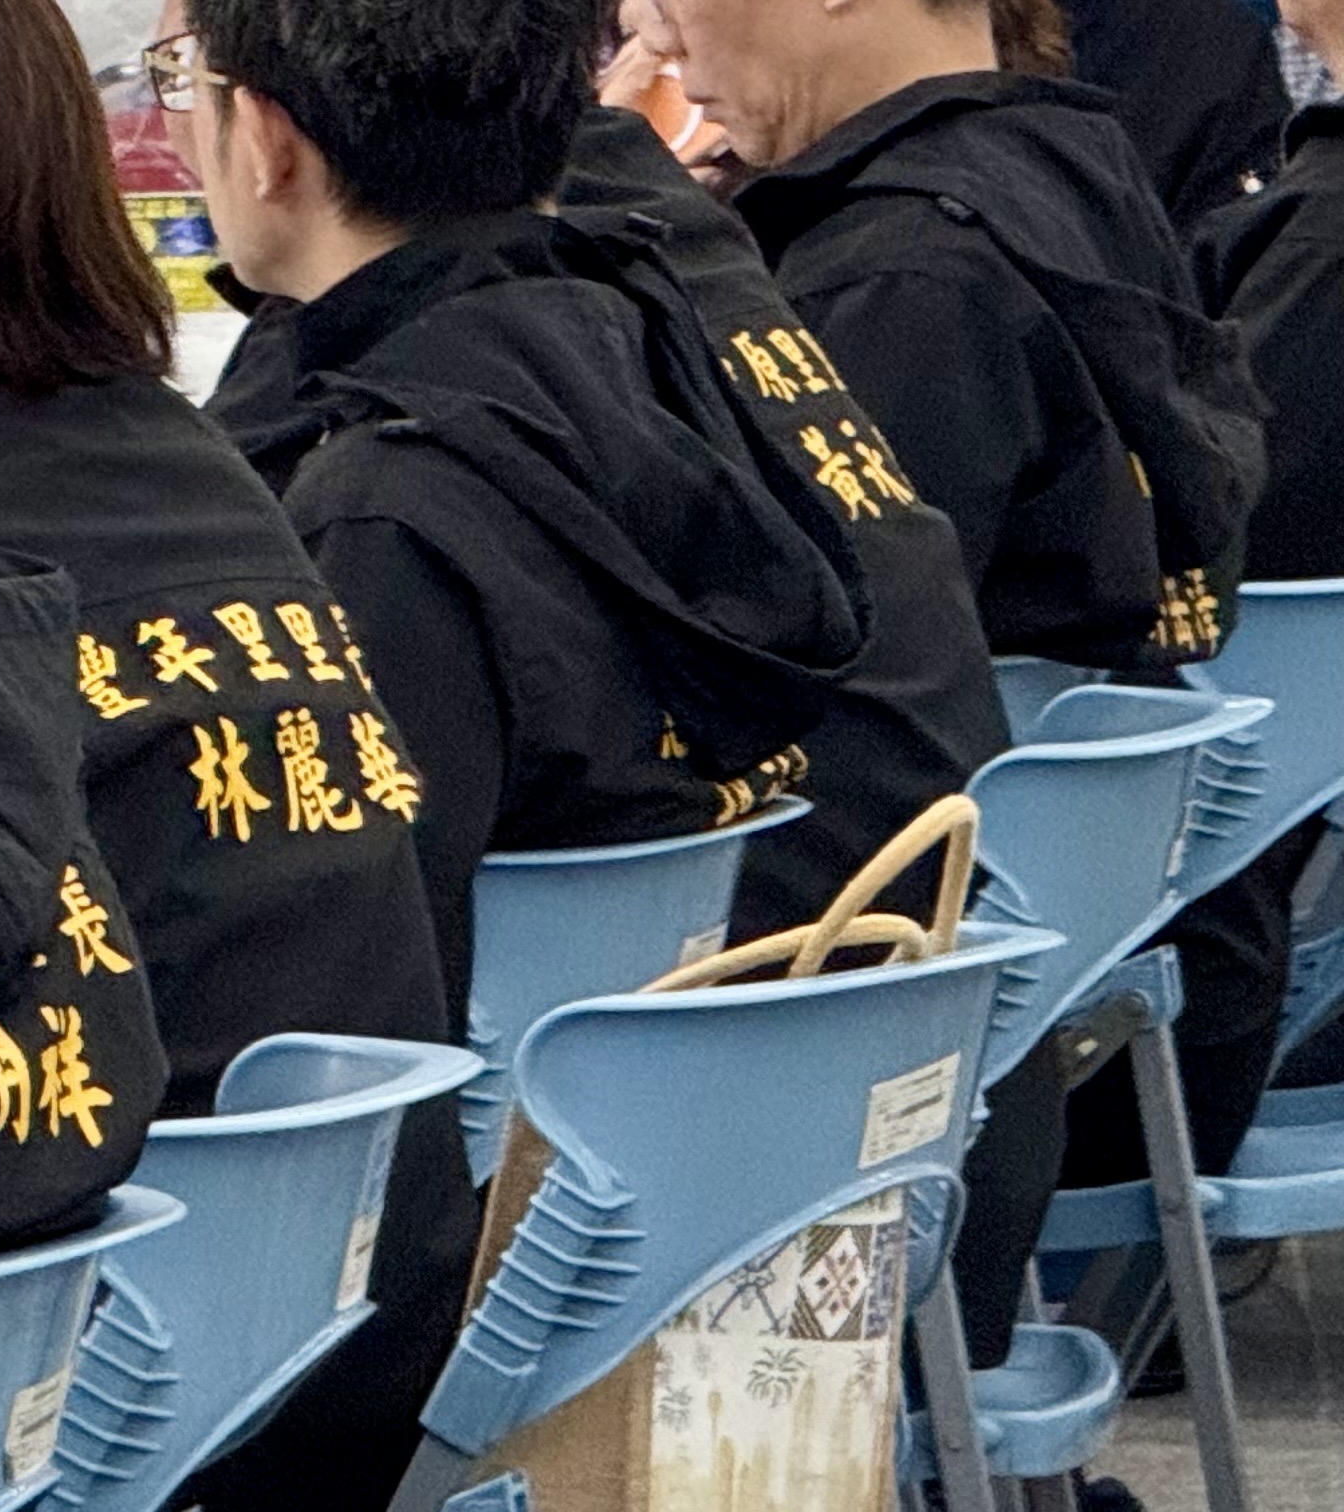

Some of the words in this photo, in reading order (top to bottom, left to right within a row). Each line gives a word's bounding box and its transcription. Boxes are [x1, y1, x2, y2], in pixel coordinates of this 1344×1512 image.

[188, 705, 422, 844] 林麗華
[59, 864, 134, 977] 長
